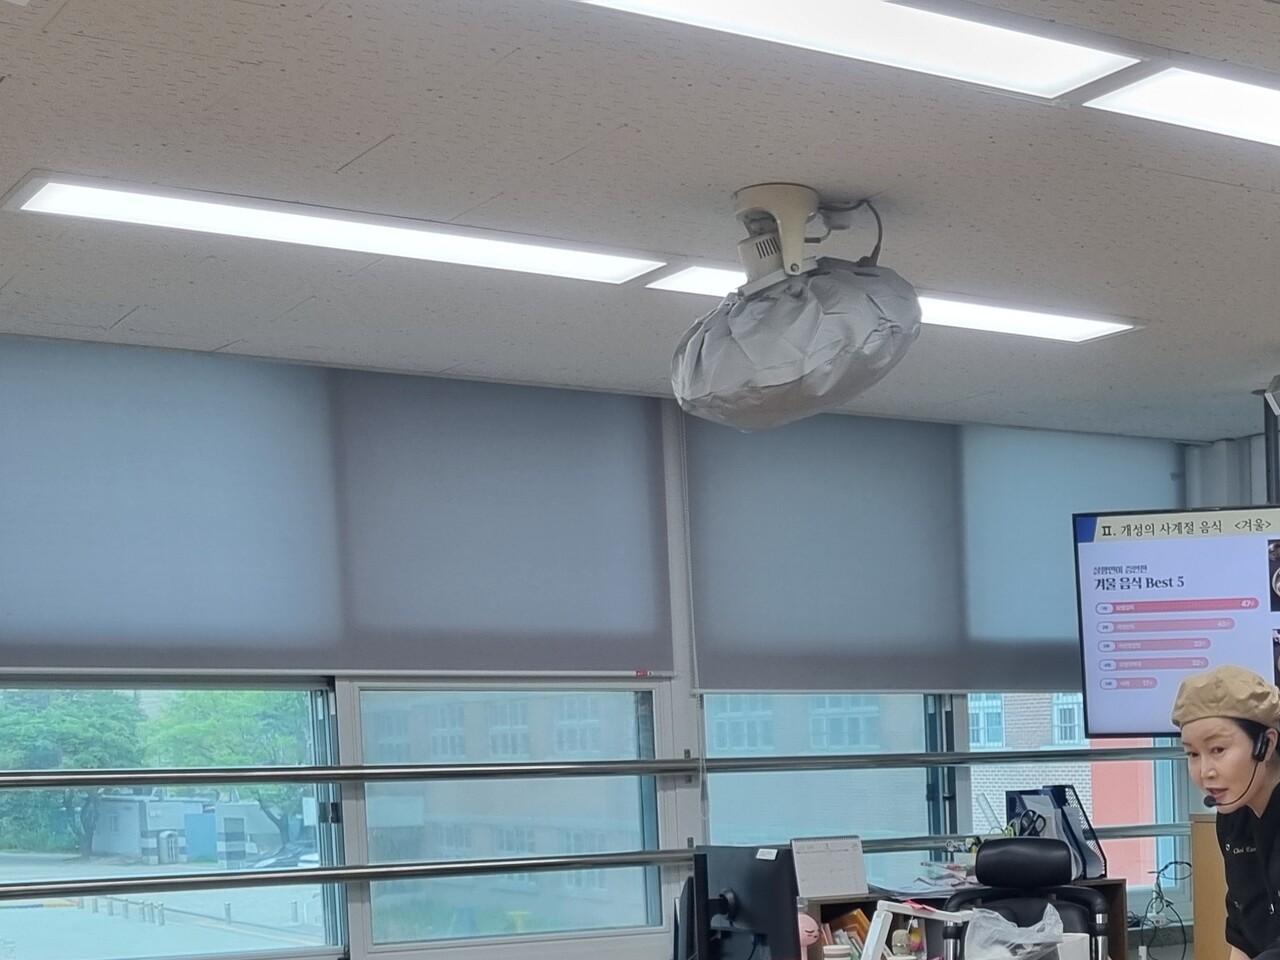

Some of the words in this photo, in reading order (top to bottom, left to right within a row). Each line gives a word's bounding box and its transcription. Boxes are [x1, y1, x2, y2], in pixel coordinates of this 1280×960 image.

[1121, 523, 1155, 537] 개성의
[1161, 521, 1194, 535] 사계절
[1200, 519, 1222, 533] 음식
[1235, 518, 1272, 532] <겨울>
[1094, 578, 1116, 591] 겨울
[1120, 577, 1142, 590] 음식
[1145, 577, 1174, 589] Best
[1177, 576, 1185, 588] 5
